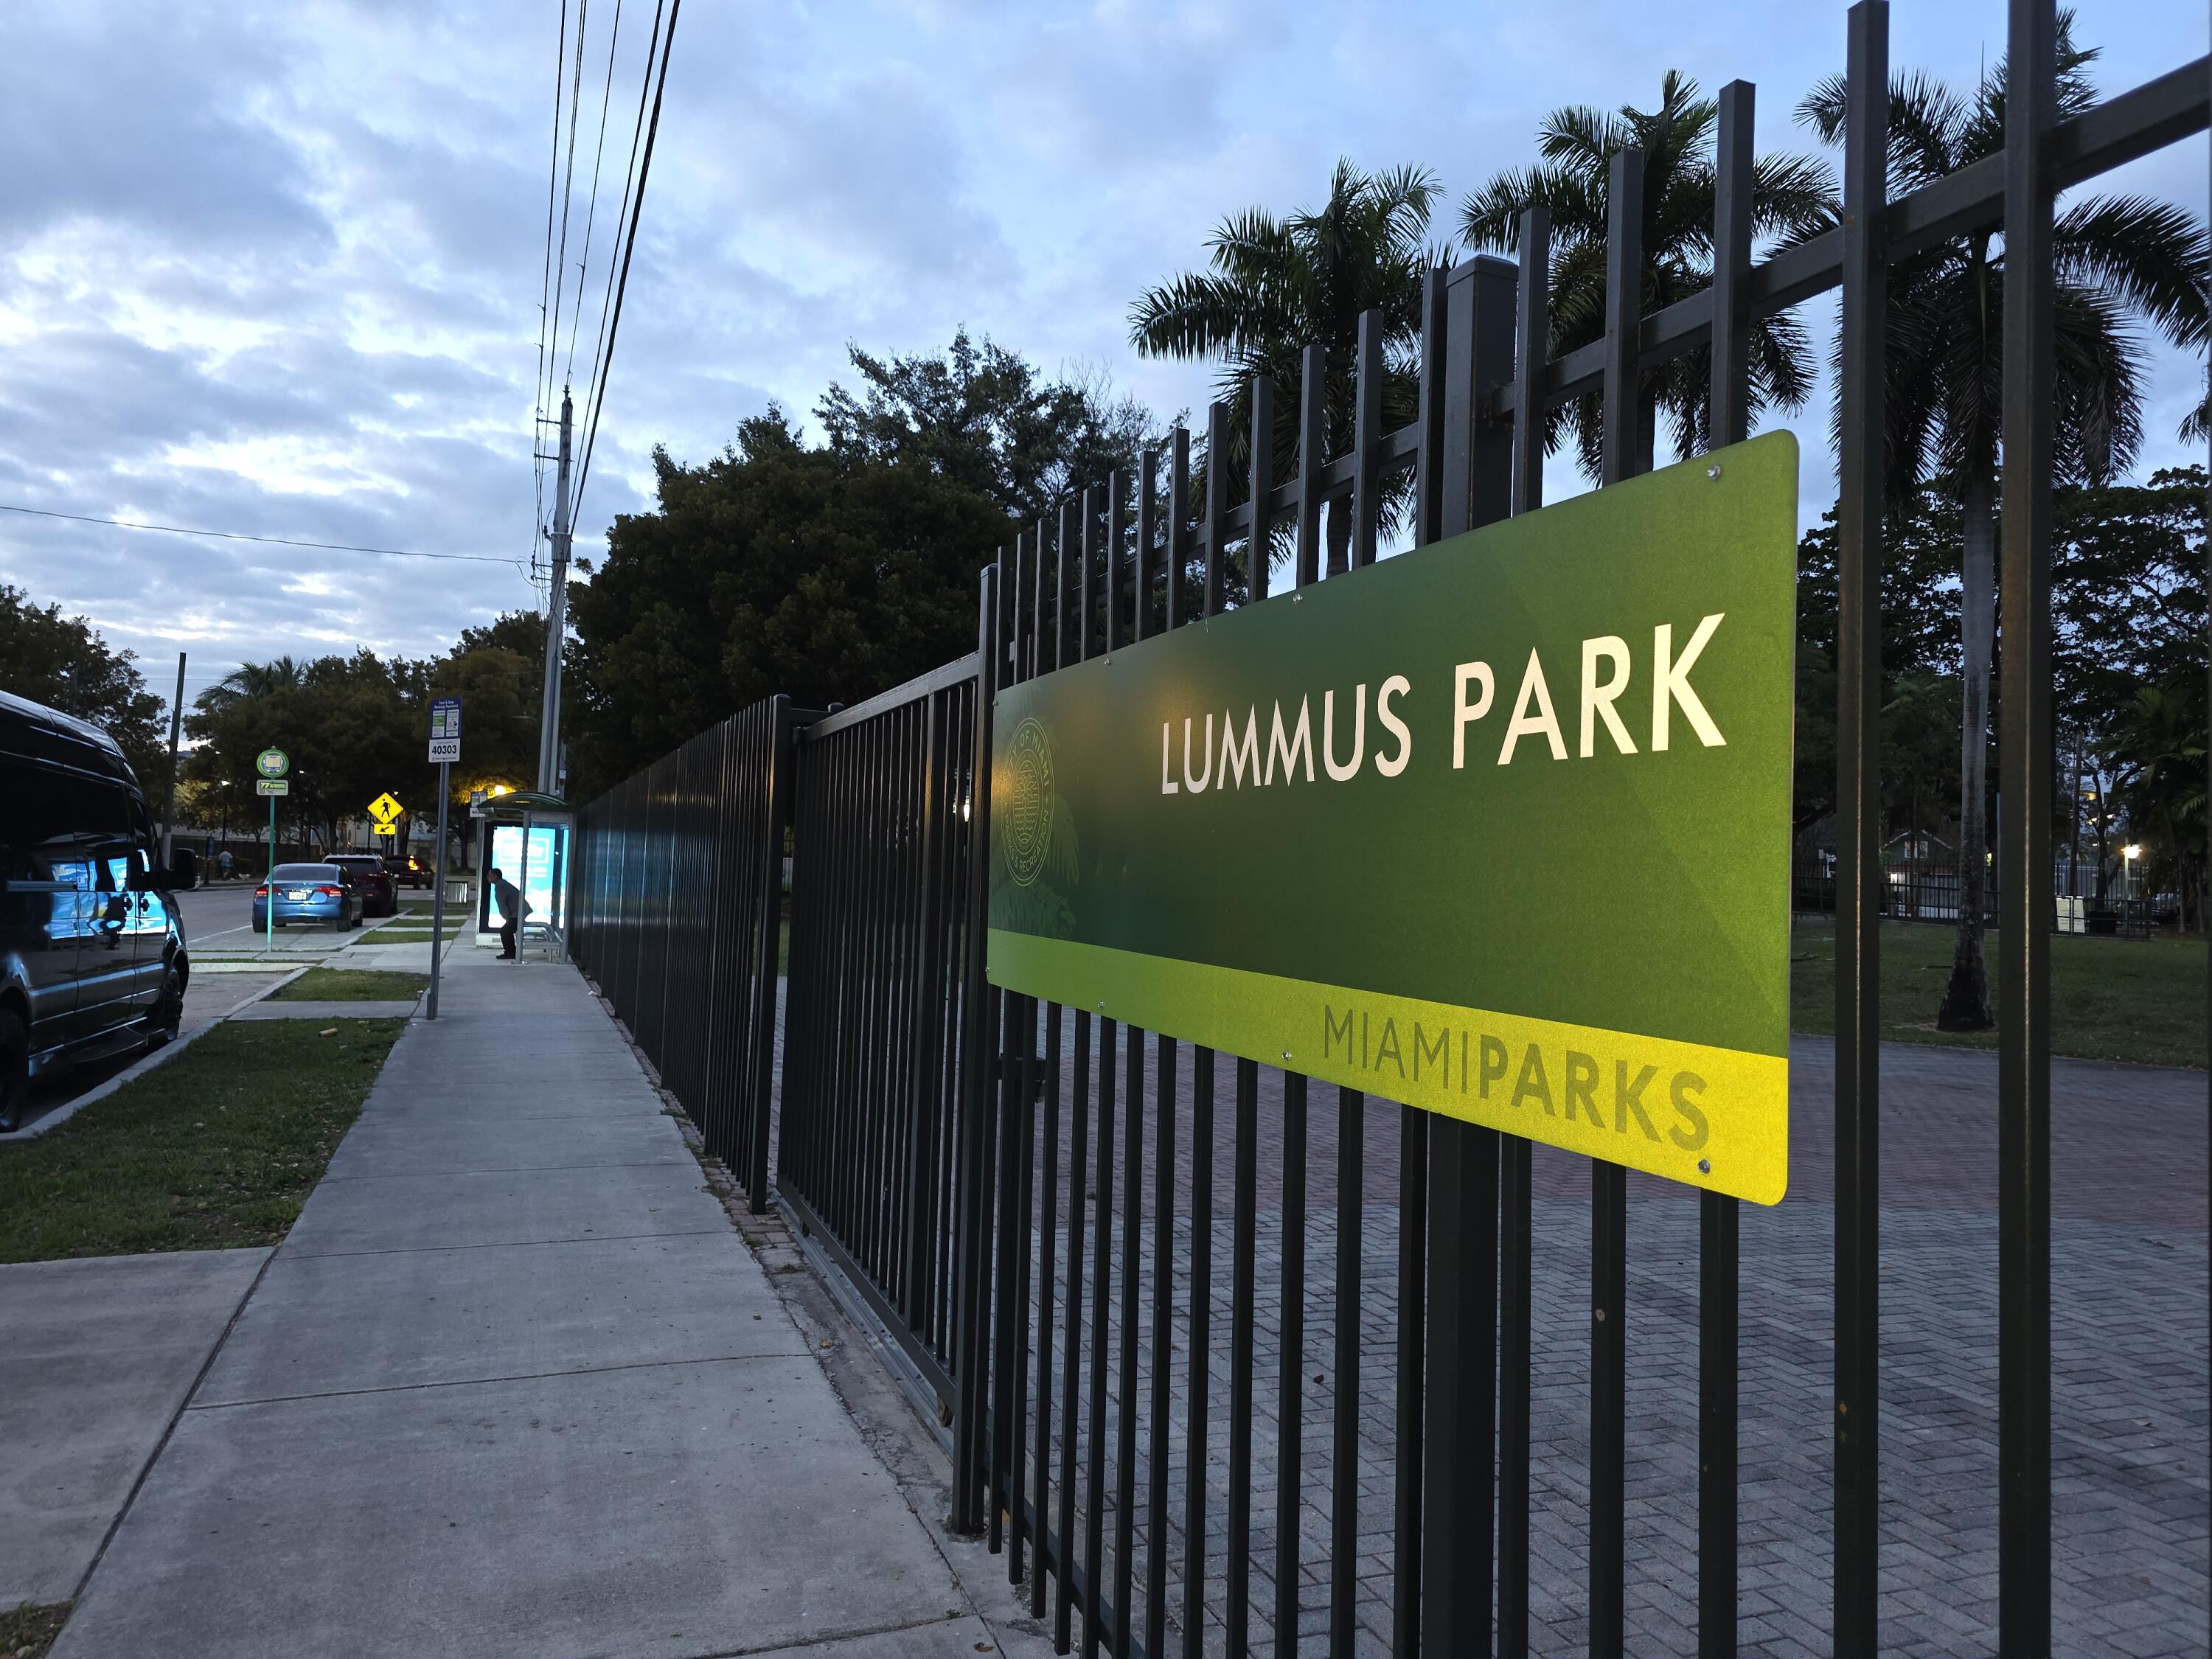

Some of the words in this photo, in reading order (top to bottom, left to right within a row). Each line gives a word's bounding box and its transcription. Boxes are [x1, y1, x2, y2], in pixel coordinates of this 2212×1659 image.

[1162, 674, 1411, 796] LUMMUS
[1452, 612, 1727, 771] PARK
[432, 745, 457, 755] 40303
[1005, 743, 1018, 792] CITY
[1020, 729, 1031, 747] OF
[1032, 731, 1050, 787] MIAMI
[1004, 813, 1015, 861] PARKS
[1019, 810, 1049, 873] RECREATION
